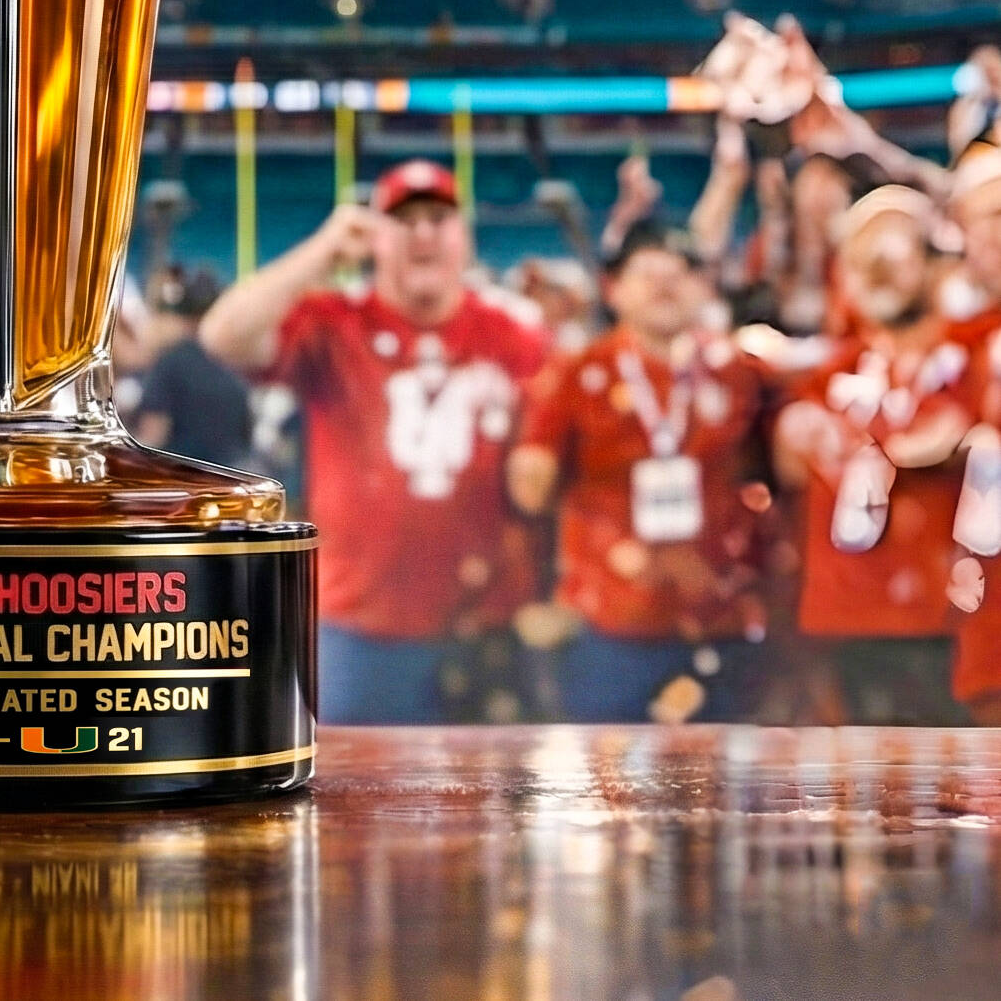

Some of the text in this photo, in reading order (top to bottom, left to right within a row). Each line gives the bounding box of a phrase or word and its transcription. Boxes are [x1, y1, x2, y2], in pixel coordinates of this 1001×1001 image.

[47, 620, 250, 663] CHAMPIONS
[95, 687, 209, 711] SEASON
[108, 727, 144, 752] 21
